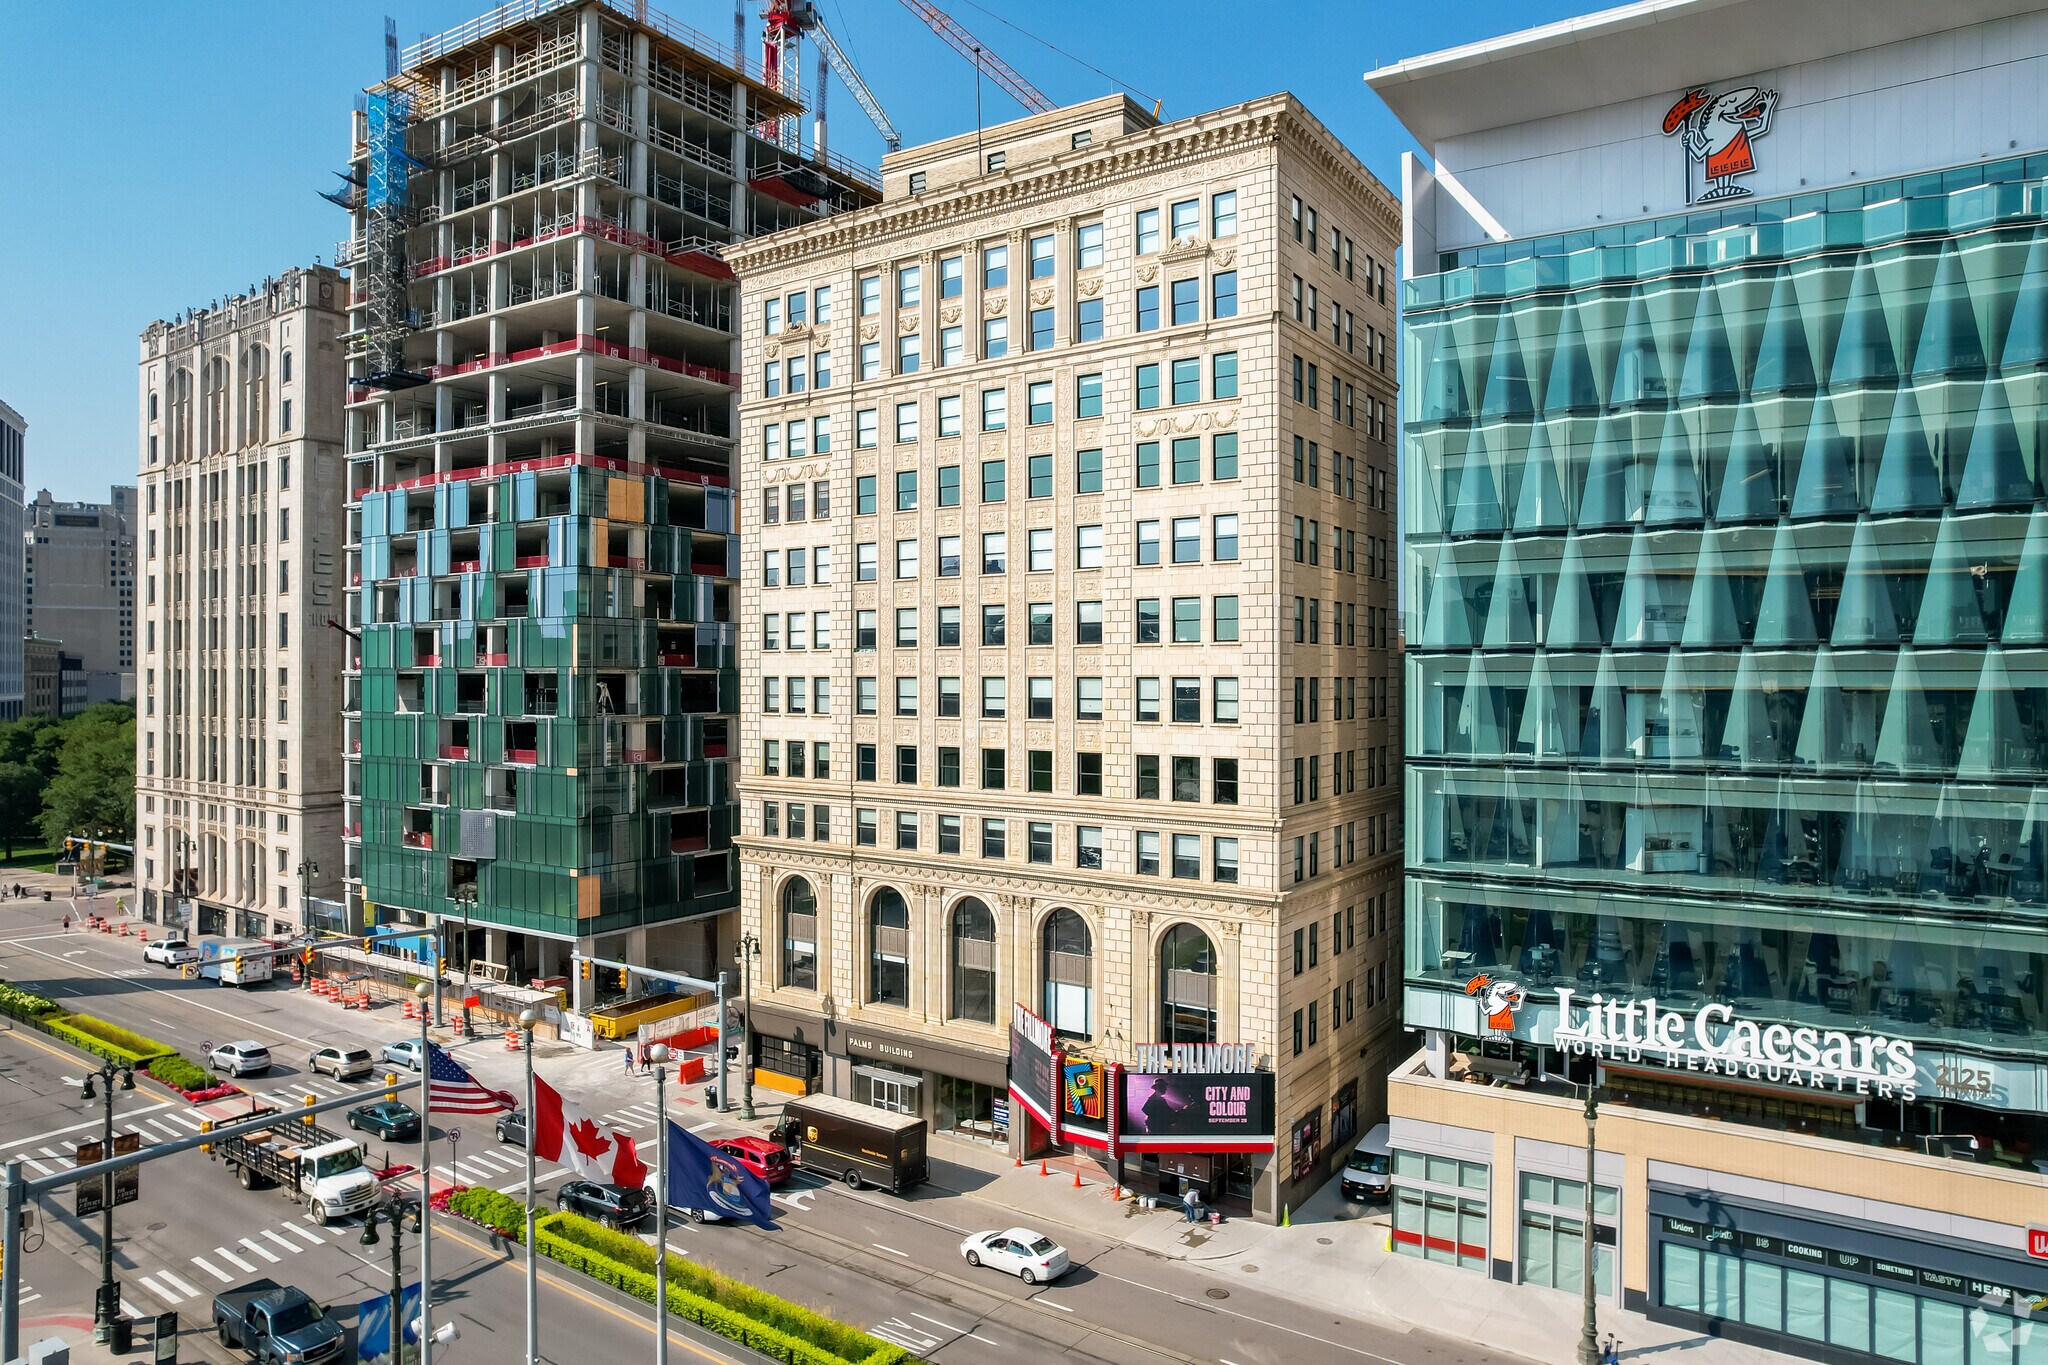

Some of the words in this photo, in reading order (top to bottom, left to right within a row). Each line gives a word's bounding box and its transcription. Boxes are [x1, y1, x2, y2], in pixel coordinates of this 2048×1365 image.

[849, 1038, 872, 1049] PALMS
[880, 1044, 913, 1058] BUILDING
[1554, 987, 1686, 1049] Little
[1694, 1003, 1916, 1080] Caesars
[1135, 1043, 1168, 1074] THE
[1171, 1043, 1256, 1074] FILLMORE
[1554, 1036, 1642, 1063] WORLD
[1666, 1051, 1916, 1101] HEADQUARTERS
[1205, 1086, 1228, 1101] CITY
[1230, 1086, 1251, 1101] AND
[1935, 1064, 1992, 1093] 2125
[1209, 1101, 1247, 1116] COLOUR
[1669, 1218, 1694, 1233] Union
[1756, 1236, 1769, 1248] IS
[1788, 1244, 1823, 1258] COOKING
[1839, 1254, 1859, 1266] UP
[1877, 1263, 1914, 1277] SOMETHING
[1923, 1271, 1961, 1287] TASTY
[1972, 1282, 2011, 1298] HERE
